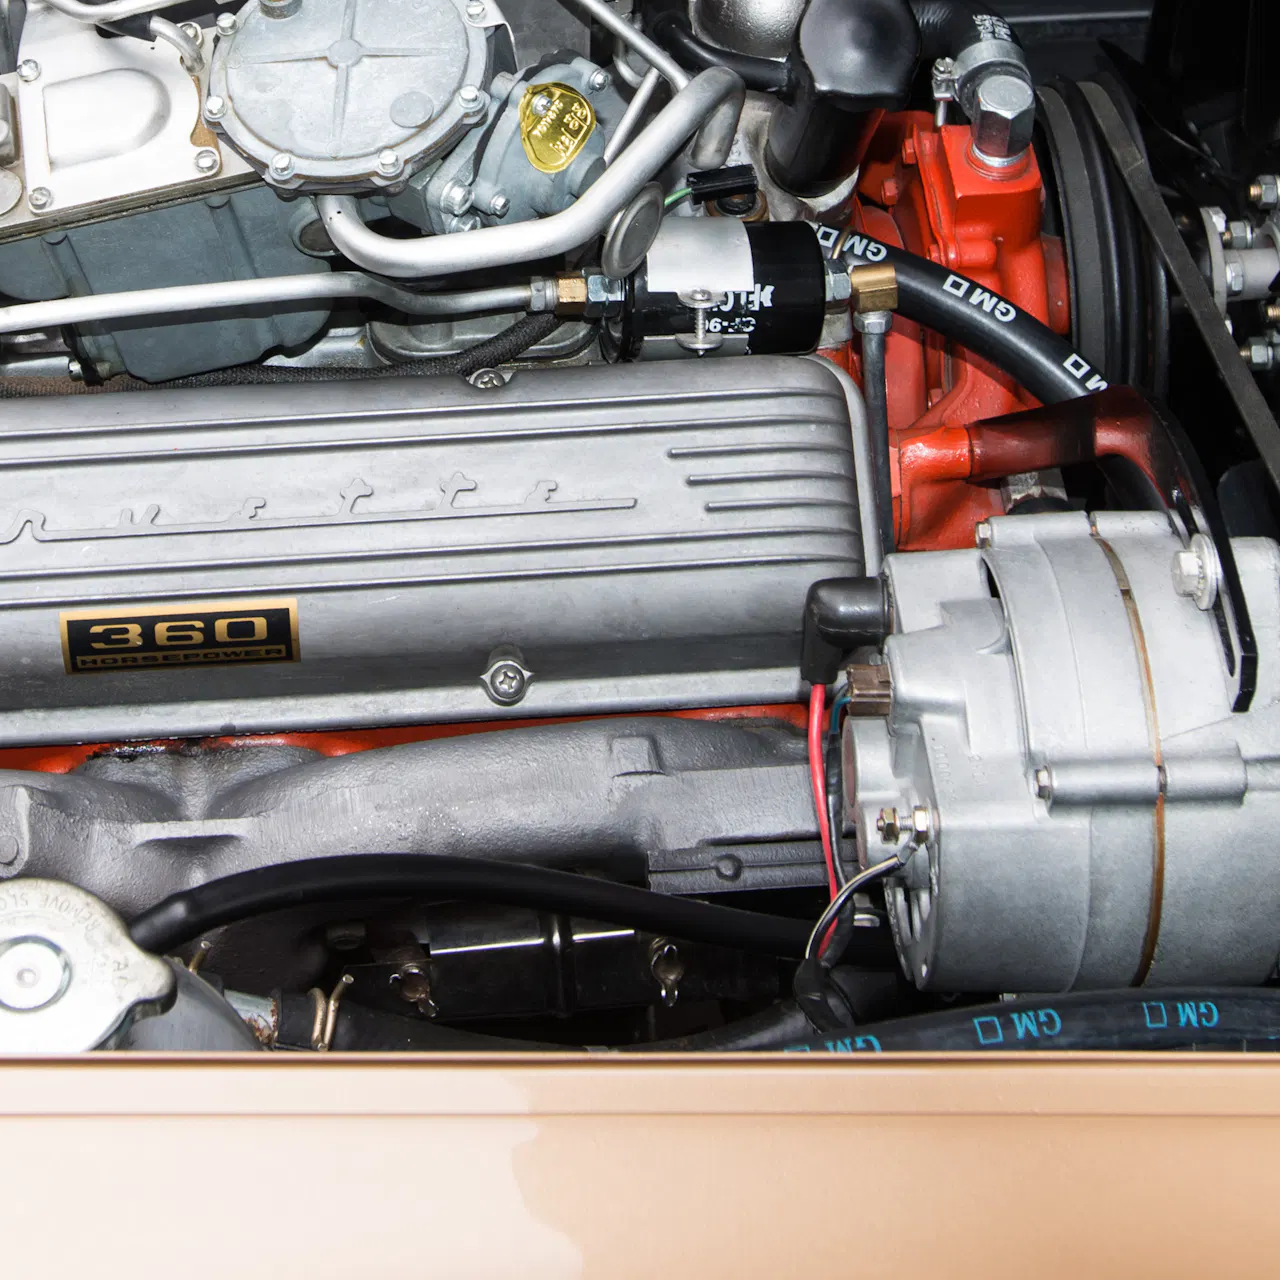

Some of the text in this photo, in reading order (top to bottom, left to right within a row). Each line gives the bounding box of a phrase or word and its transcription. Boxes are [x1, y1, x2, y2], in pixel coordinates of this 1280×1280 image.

[842, 234, 888, 263] GM
[968, 287, 1017, 322] GM
[89, 616, 268, 650] 360
[80, 647, 283, 667] HORSEPOWER
[1010, 1008, 1062, 1039] GM
[1178, 1001, 1220, 1029] GM
